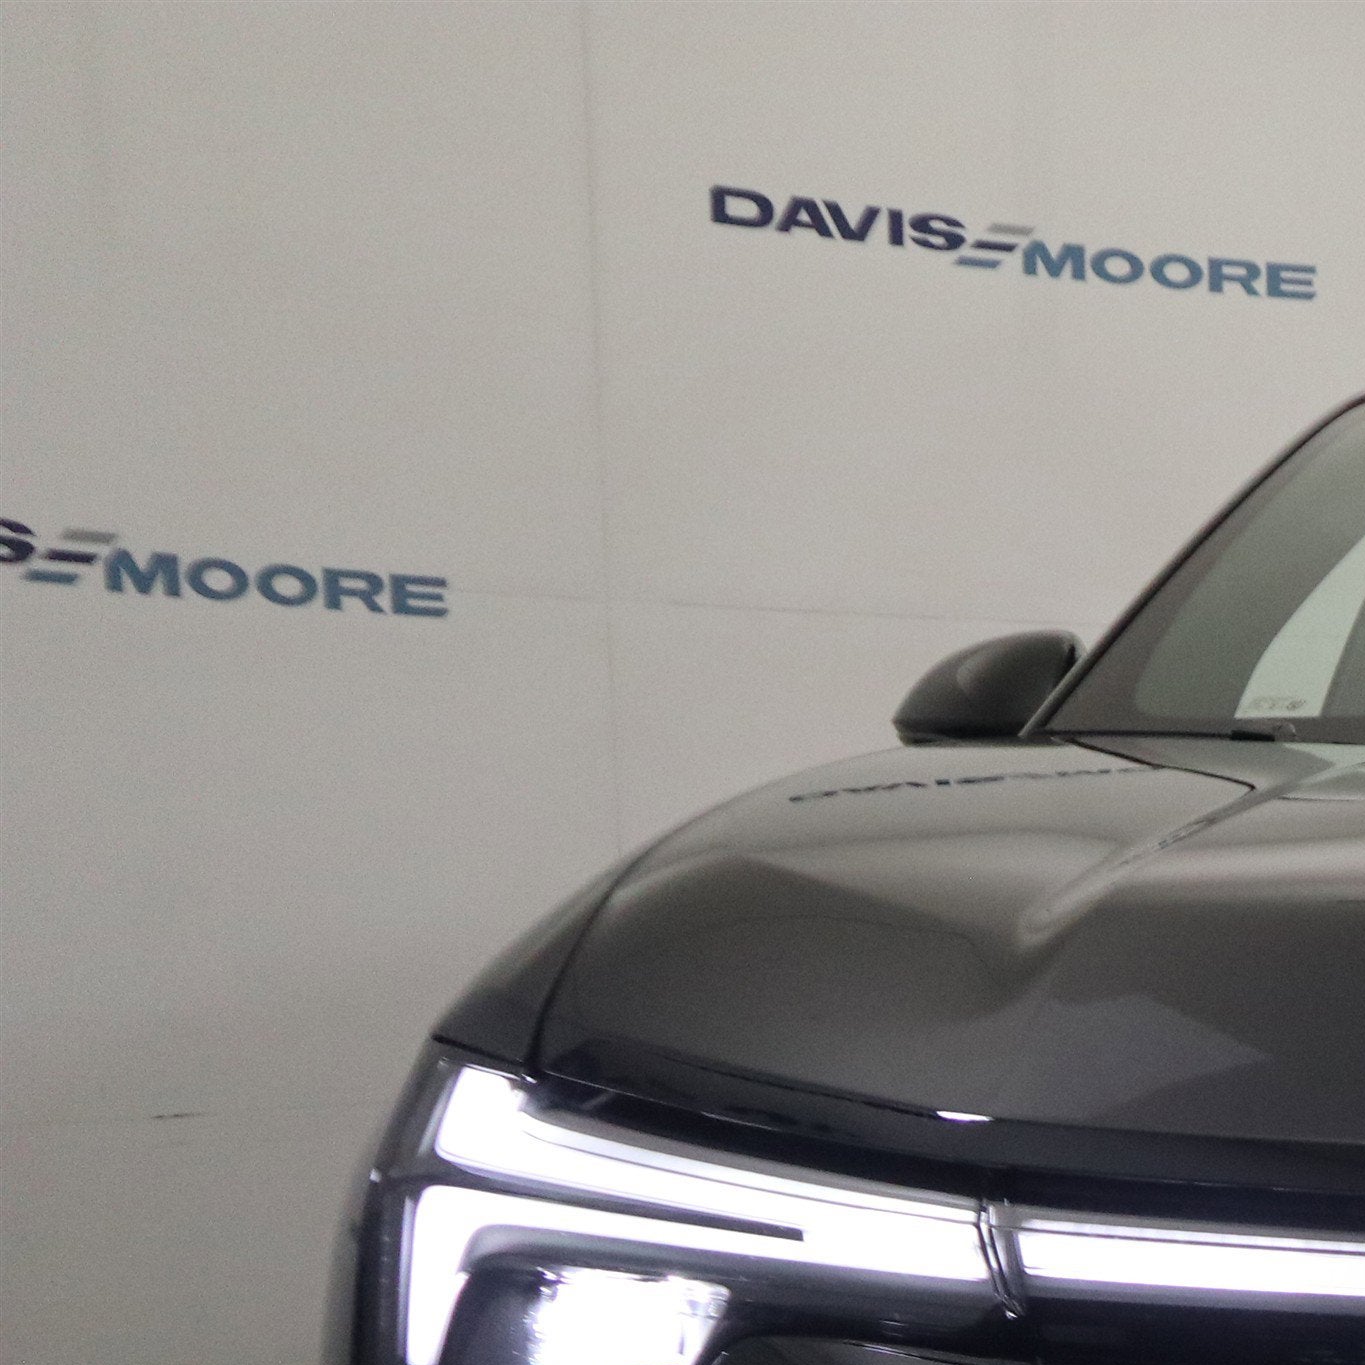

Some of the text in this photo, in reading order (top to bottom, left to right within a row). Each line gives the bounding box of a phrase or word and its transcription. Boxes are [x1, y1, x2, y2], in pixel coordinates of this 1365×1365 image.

[709, 184, 1318, 301] DAVIS MOORE
[103, 547, 450, 618] MOORE
